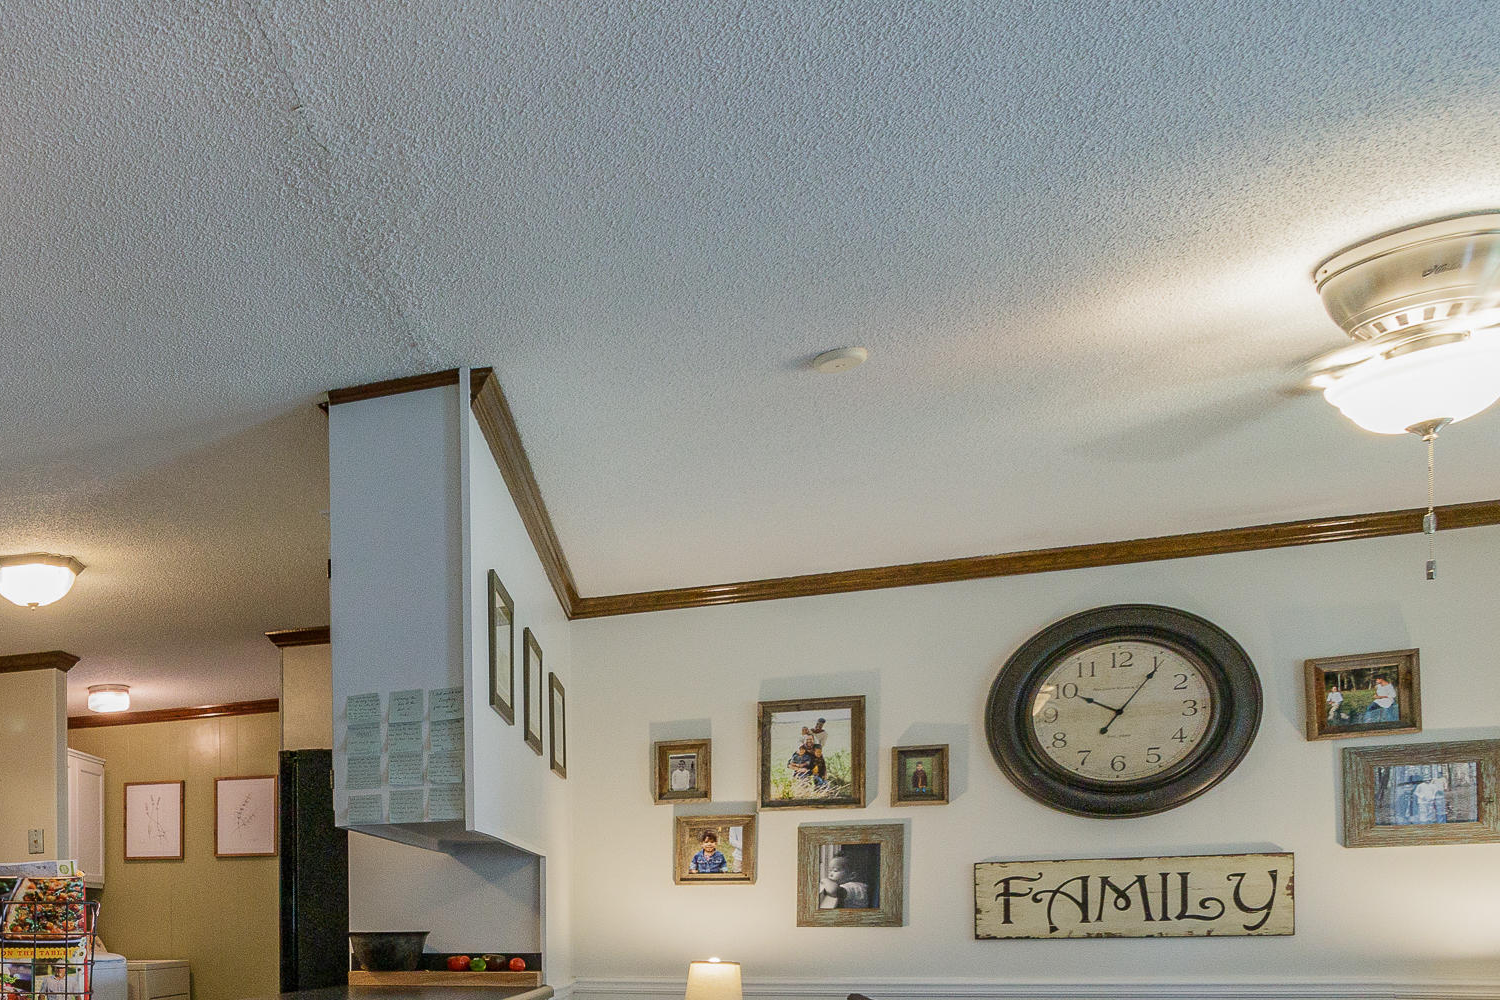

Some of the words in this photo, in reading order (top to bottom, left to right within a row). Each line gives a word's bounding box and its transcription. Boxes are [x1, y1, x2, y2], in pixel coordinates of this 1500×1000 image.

[1111, 651, 1133, 668] 12
[1152, 656, 1159, 672] 1
[1077, 661, 1096, 678] 11
[1173, 674, 1188, 690] 2
[1055, 682, 1078, 699] 10
[1043, 707, 1058, 723] 9
[1182, 700, 1198, 716] 3
[1052, 732, 1067, 748] 8
[1171, 727, 1188, 743] 4
[1077, 750, 1092, 766] 7
[1146, 747, 1161, 763] 5
[1110, 755, 1126, 772] 6
[994, 869, 1278, 934] FAMILY
